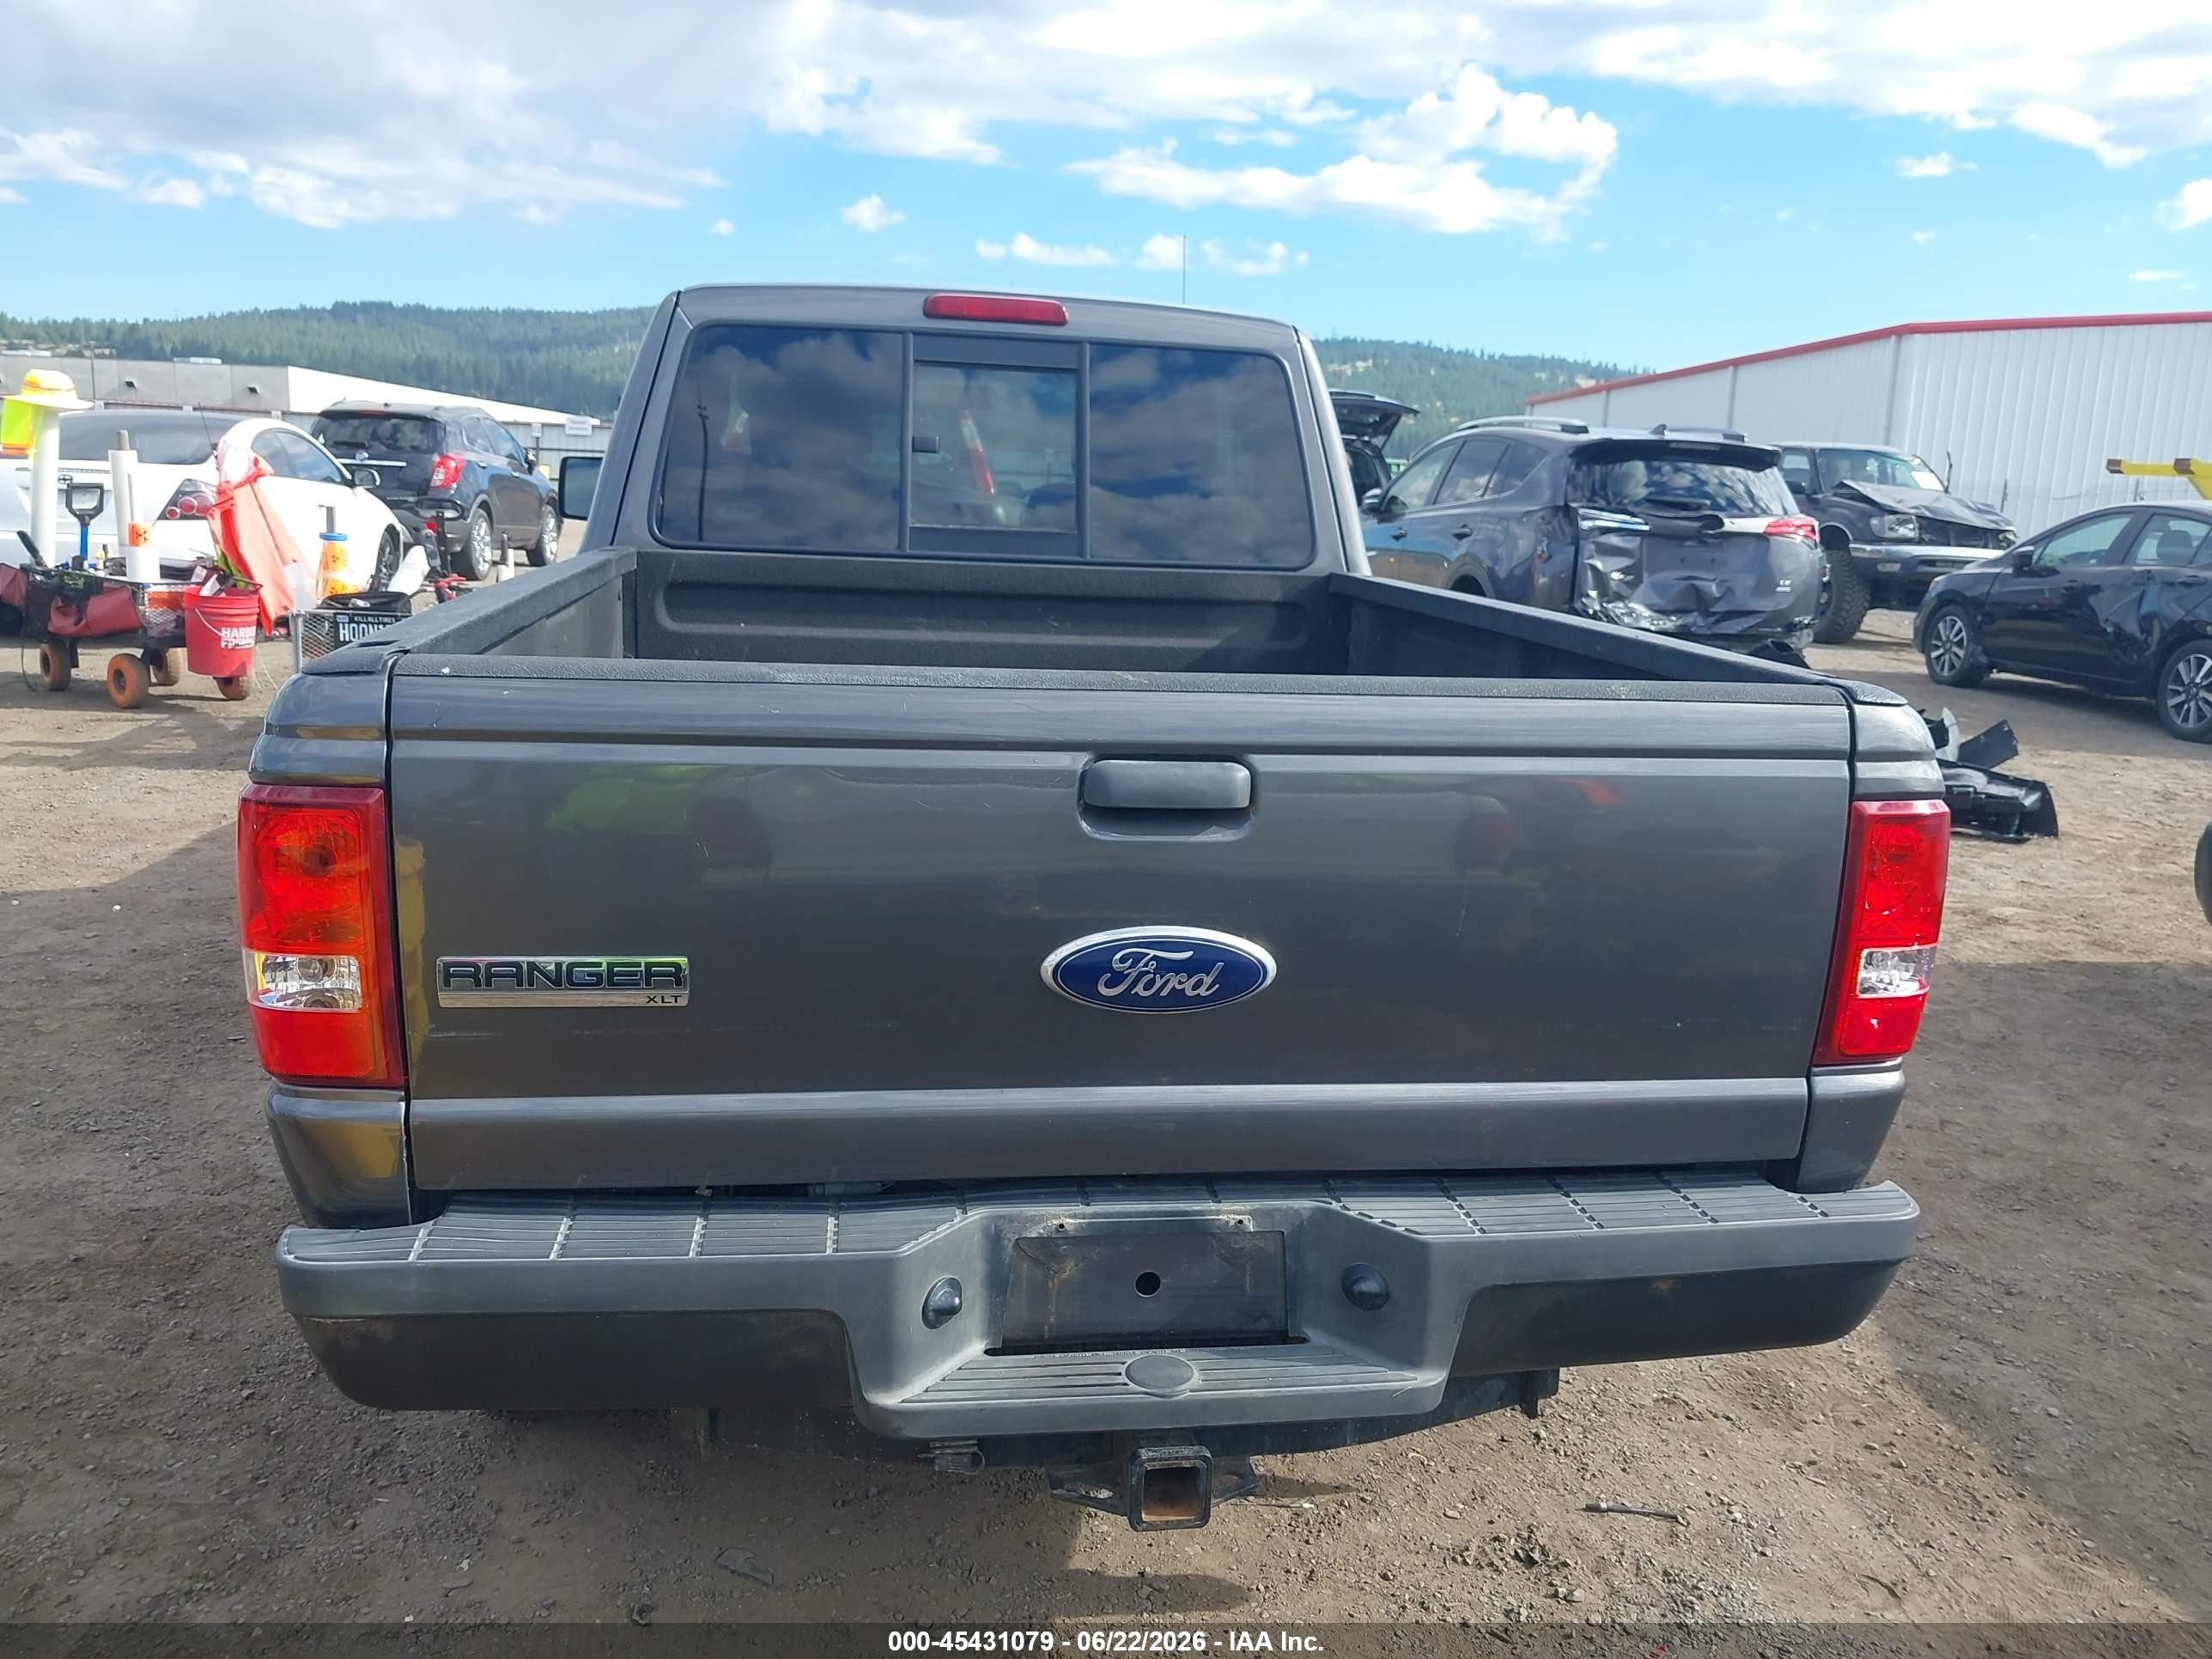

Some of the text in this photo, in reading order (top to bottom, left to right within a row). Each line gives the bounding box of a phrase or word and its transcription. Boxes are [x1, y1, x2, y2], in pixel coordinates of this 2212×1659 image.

[338, 623, 386, 642] HOON
[441, 960, 685, 989] RANGER
[1097, 947, 1224, 997] Ford
[645, 994, 683, 1005] XLT
